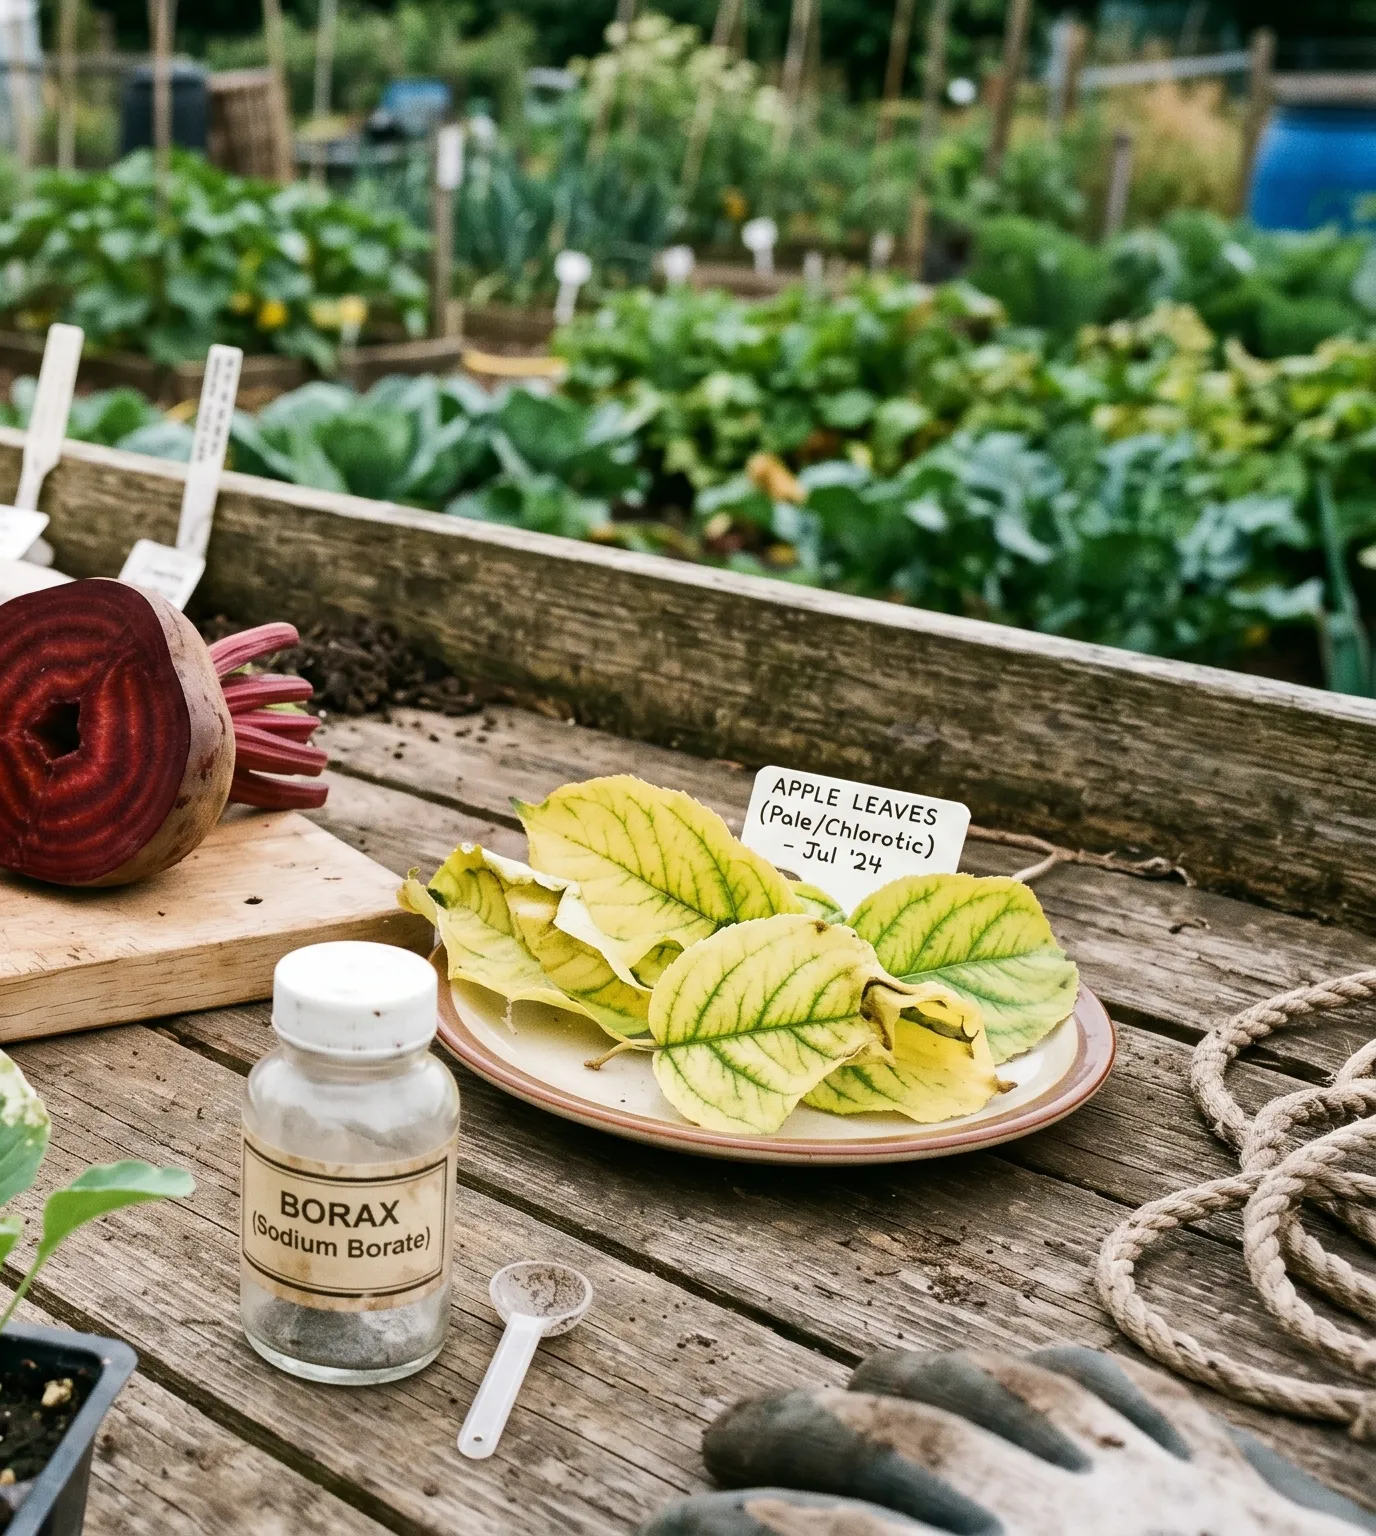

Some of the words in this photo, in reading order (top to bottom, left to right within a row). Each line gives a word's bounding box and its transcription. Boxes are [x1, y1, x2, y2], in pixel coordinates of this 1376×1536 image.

[771, 777, 841, 807] APPLE
[852, 793, 938, 826] LEAVES
[760, 799, 935, 859] (Pale/Chlorotic)
[802, 841, 838, 864] Jul
[850, 849, 883, 874] '24
[280, 1190, 400, 1229] BORAX
[252, 1210, 338, 1258] (Sodium
[347, 1226, 431, 1259] Borate)
